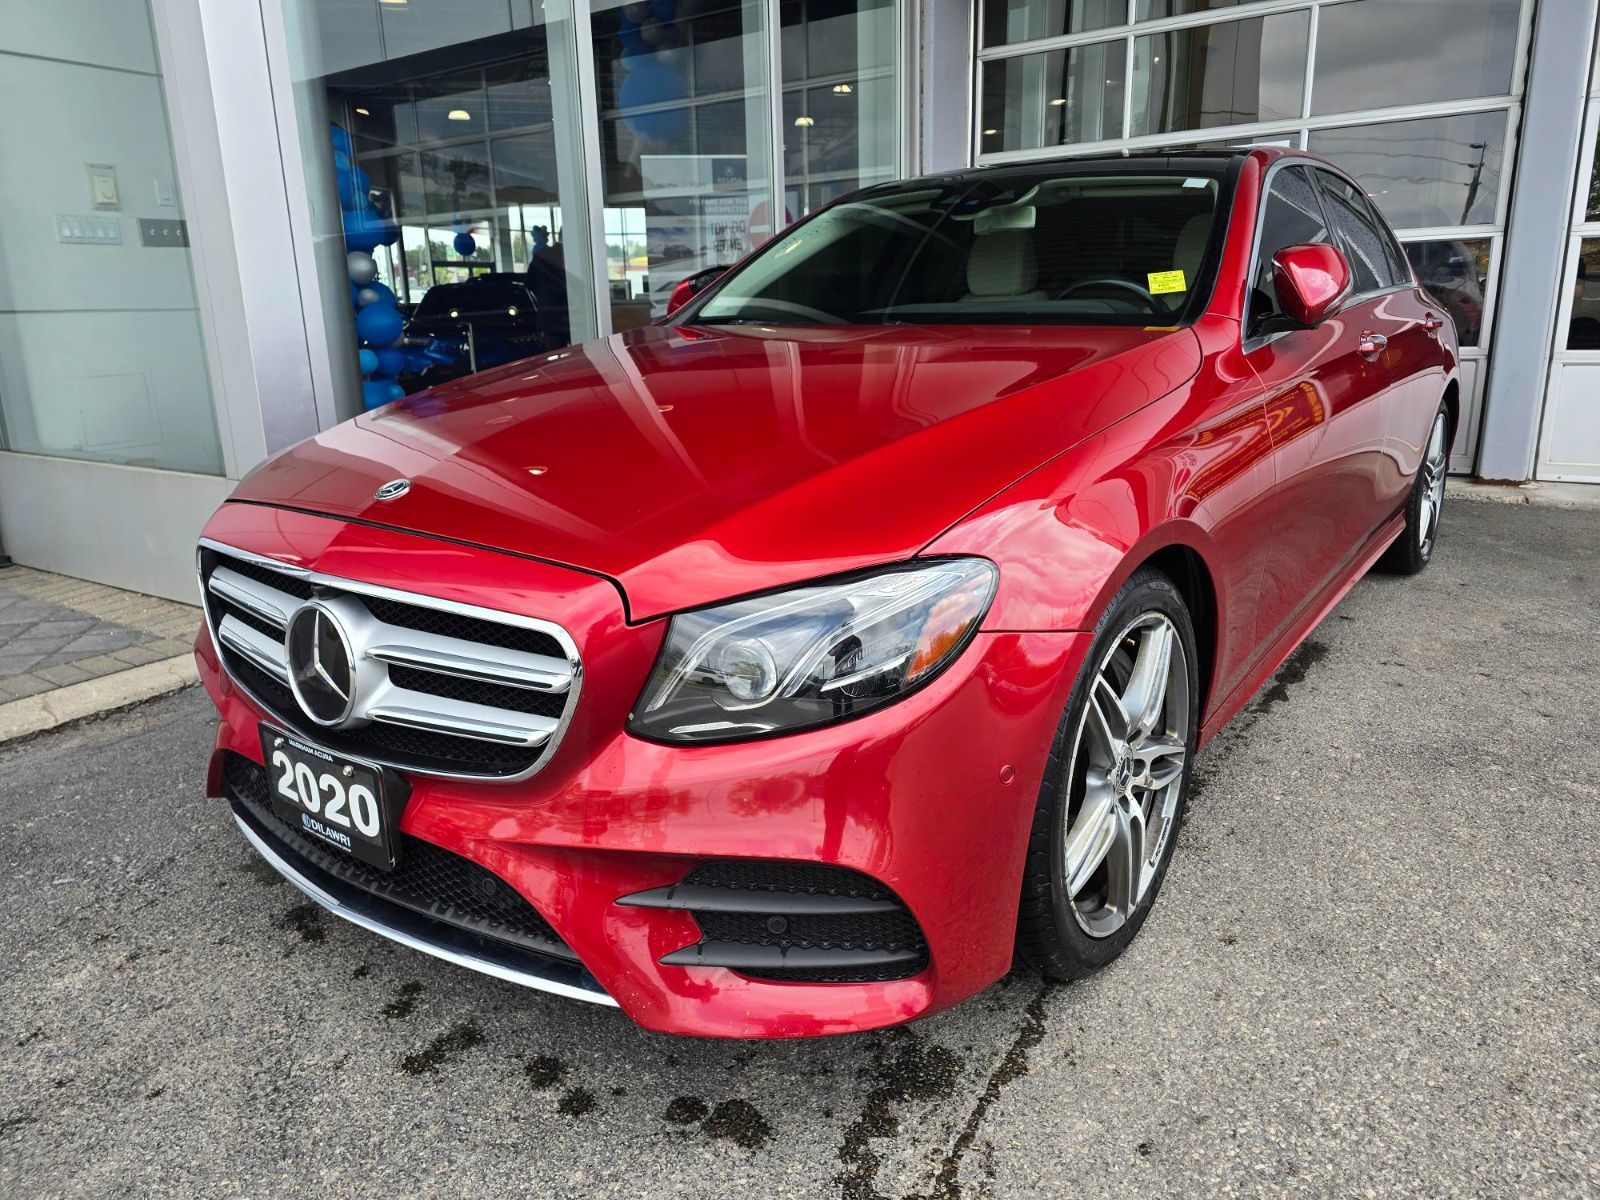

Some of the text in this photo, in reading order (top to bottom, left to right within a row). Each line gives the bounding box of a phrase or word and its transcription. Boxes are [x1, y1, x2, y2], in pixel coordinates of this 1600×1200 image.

[314, 749, 334, 763] ACURA
[272, 750, 380, 837] 2020
[310, 818, 351, 847] DILAWRI
